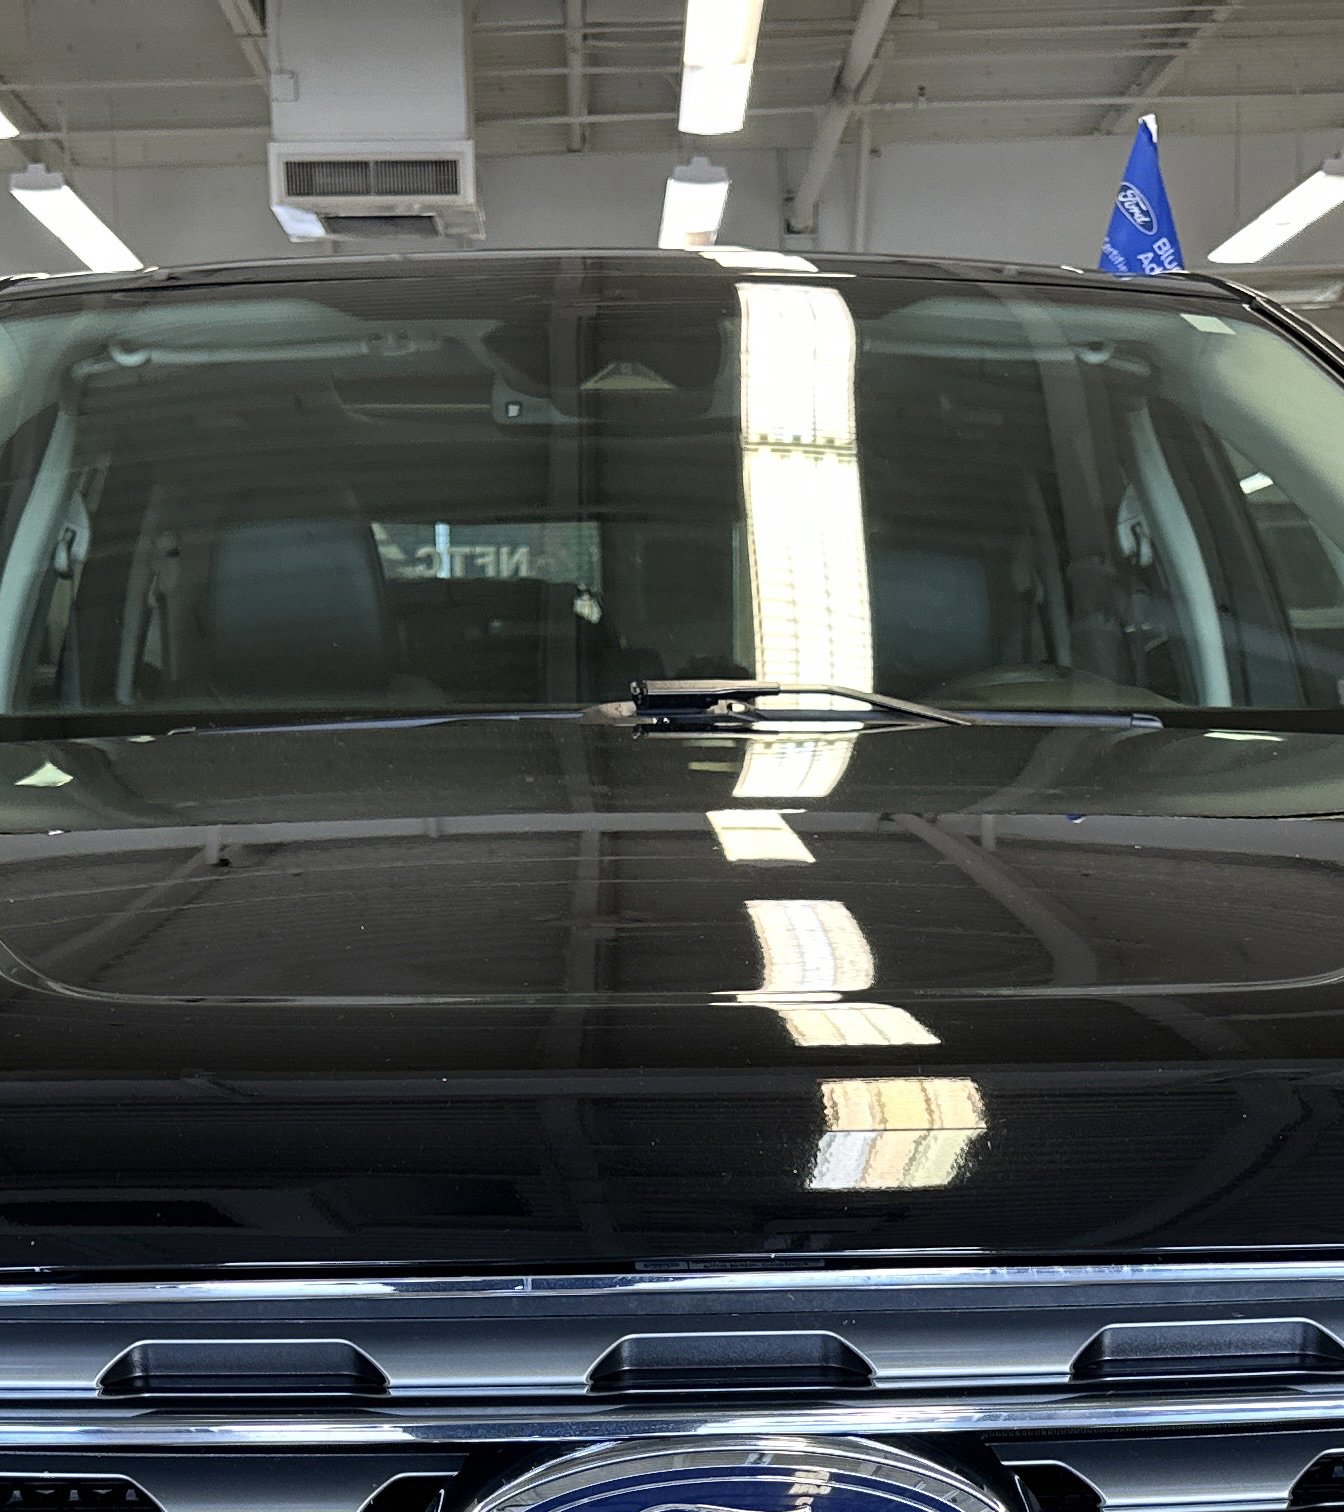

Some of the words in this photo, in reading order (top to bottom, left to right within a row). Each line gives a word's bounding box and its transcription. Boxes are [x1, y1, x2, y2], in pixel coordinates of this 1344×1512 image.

[1117, 189, 1152, 225] Ford
[1137, 252, 1163, 275] Ad
[1153, 237, 1181, 271] Blu
